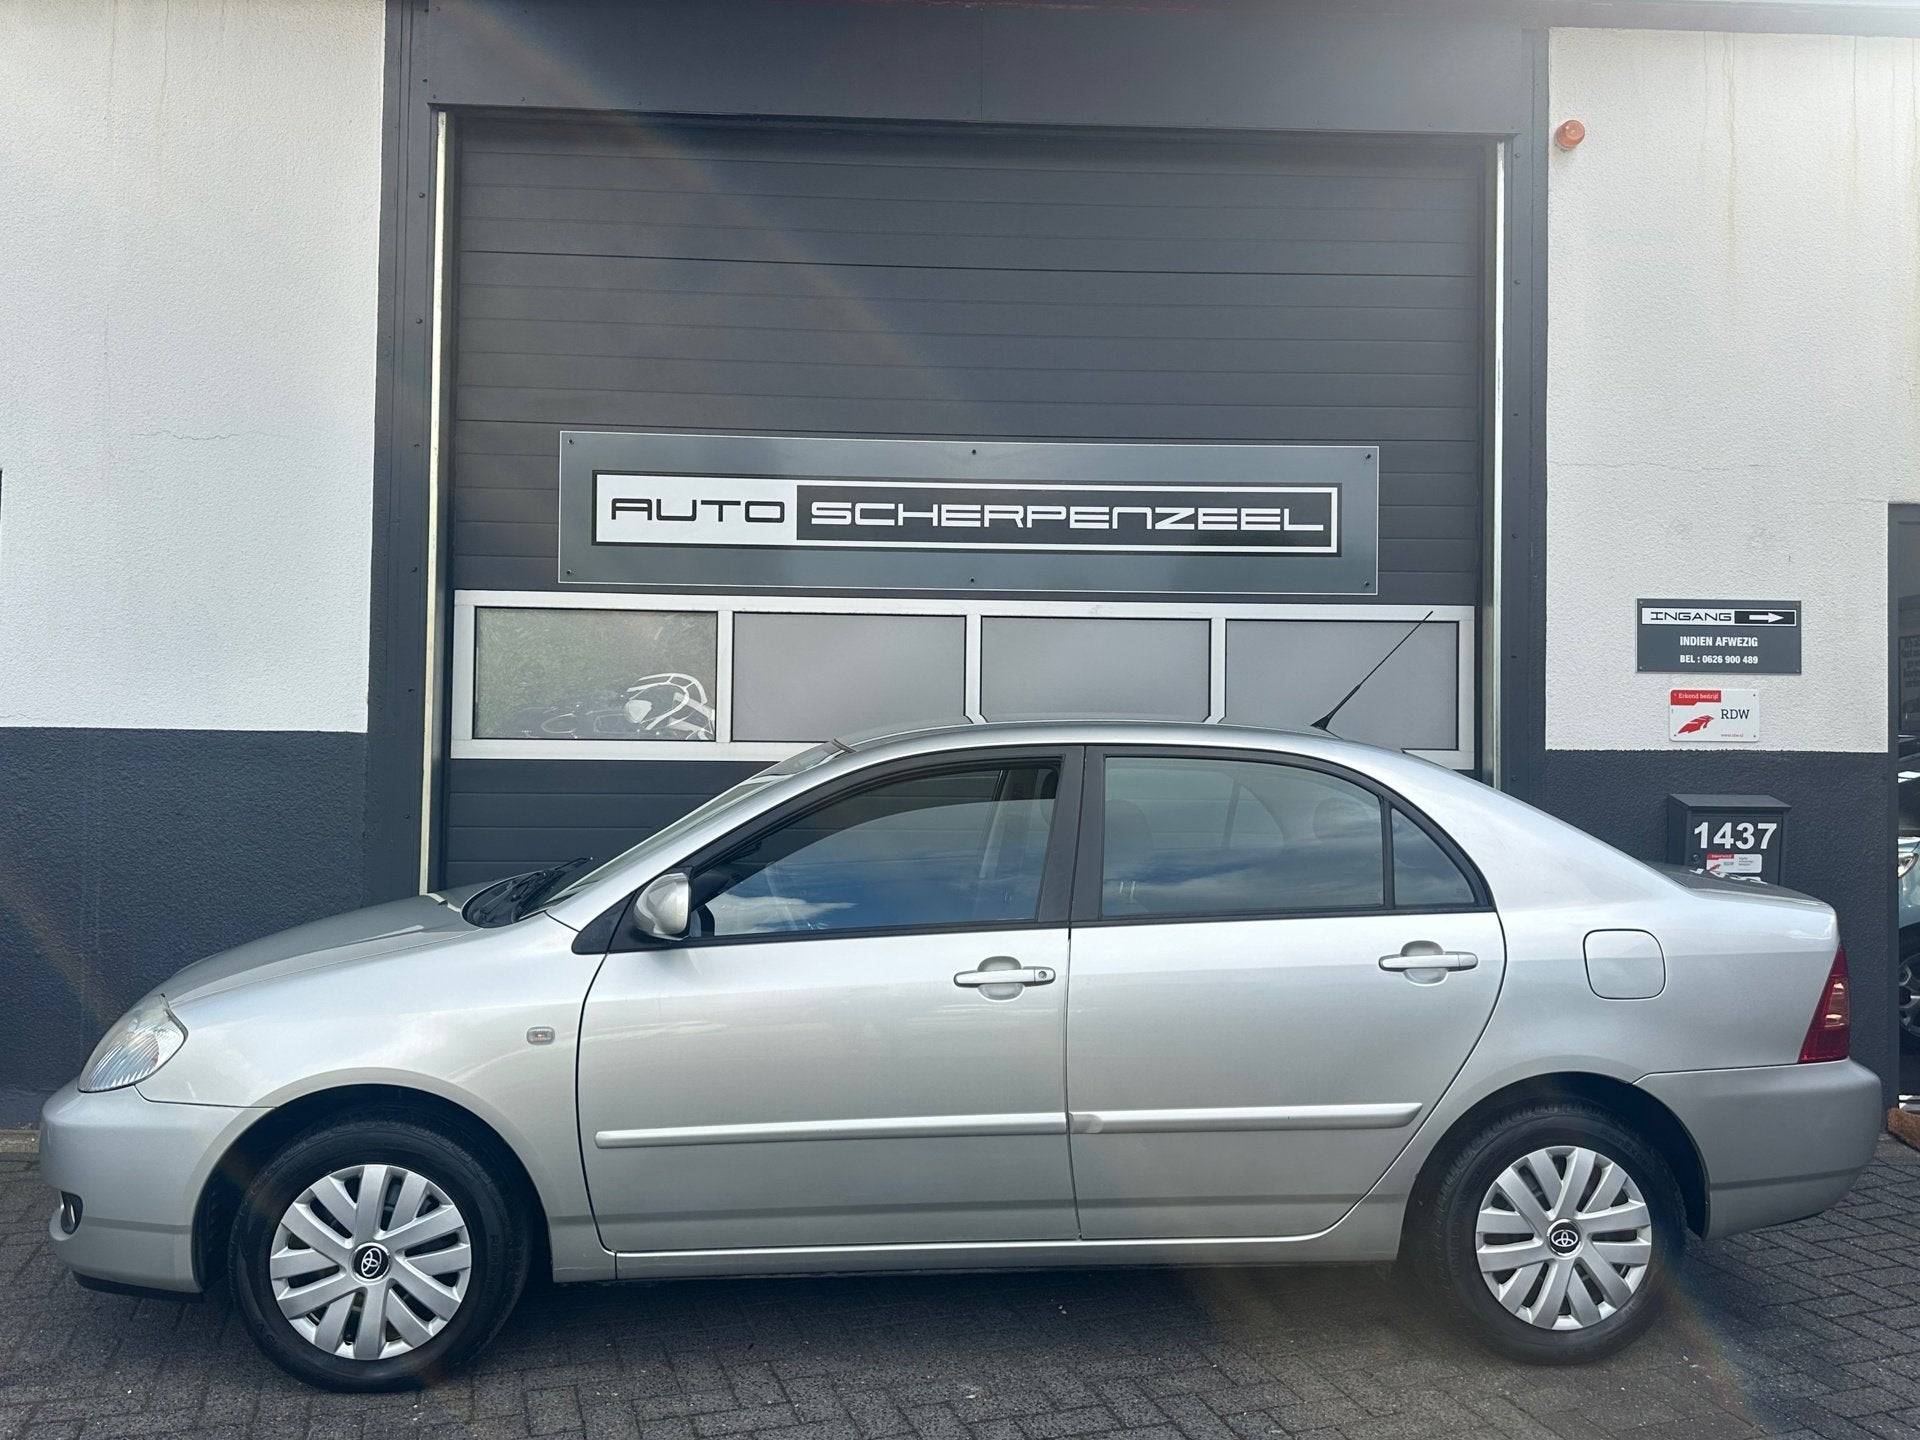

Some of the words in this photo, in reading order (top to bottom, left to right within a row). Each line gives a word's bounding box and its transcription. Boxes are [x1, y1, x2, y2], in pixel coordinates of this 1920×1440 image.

[610, 498, 786, 524] AUTO
[810, 501, 1324, 532] SCHERPENZEEL
[1650, 611, 1732, 622] INGANG
[1680, 636, 1713, 646] INDIEN
[1715, 636, 1758, 647] AFWEZIG
[1680, 655, 1696, 663] BEL
[1702, 655, 1723, 664] 0626
[1725, 655, 1741, 664] 900
[1742, 655, 1759, 664] 489
[1721, 709, 1750, 720] RDW
[1694, 821, 1777, 849] 1437
